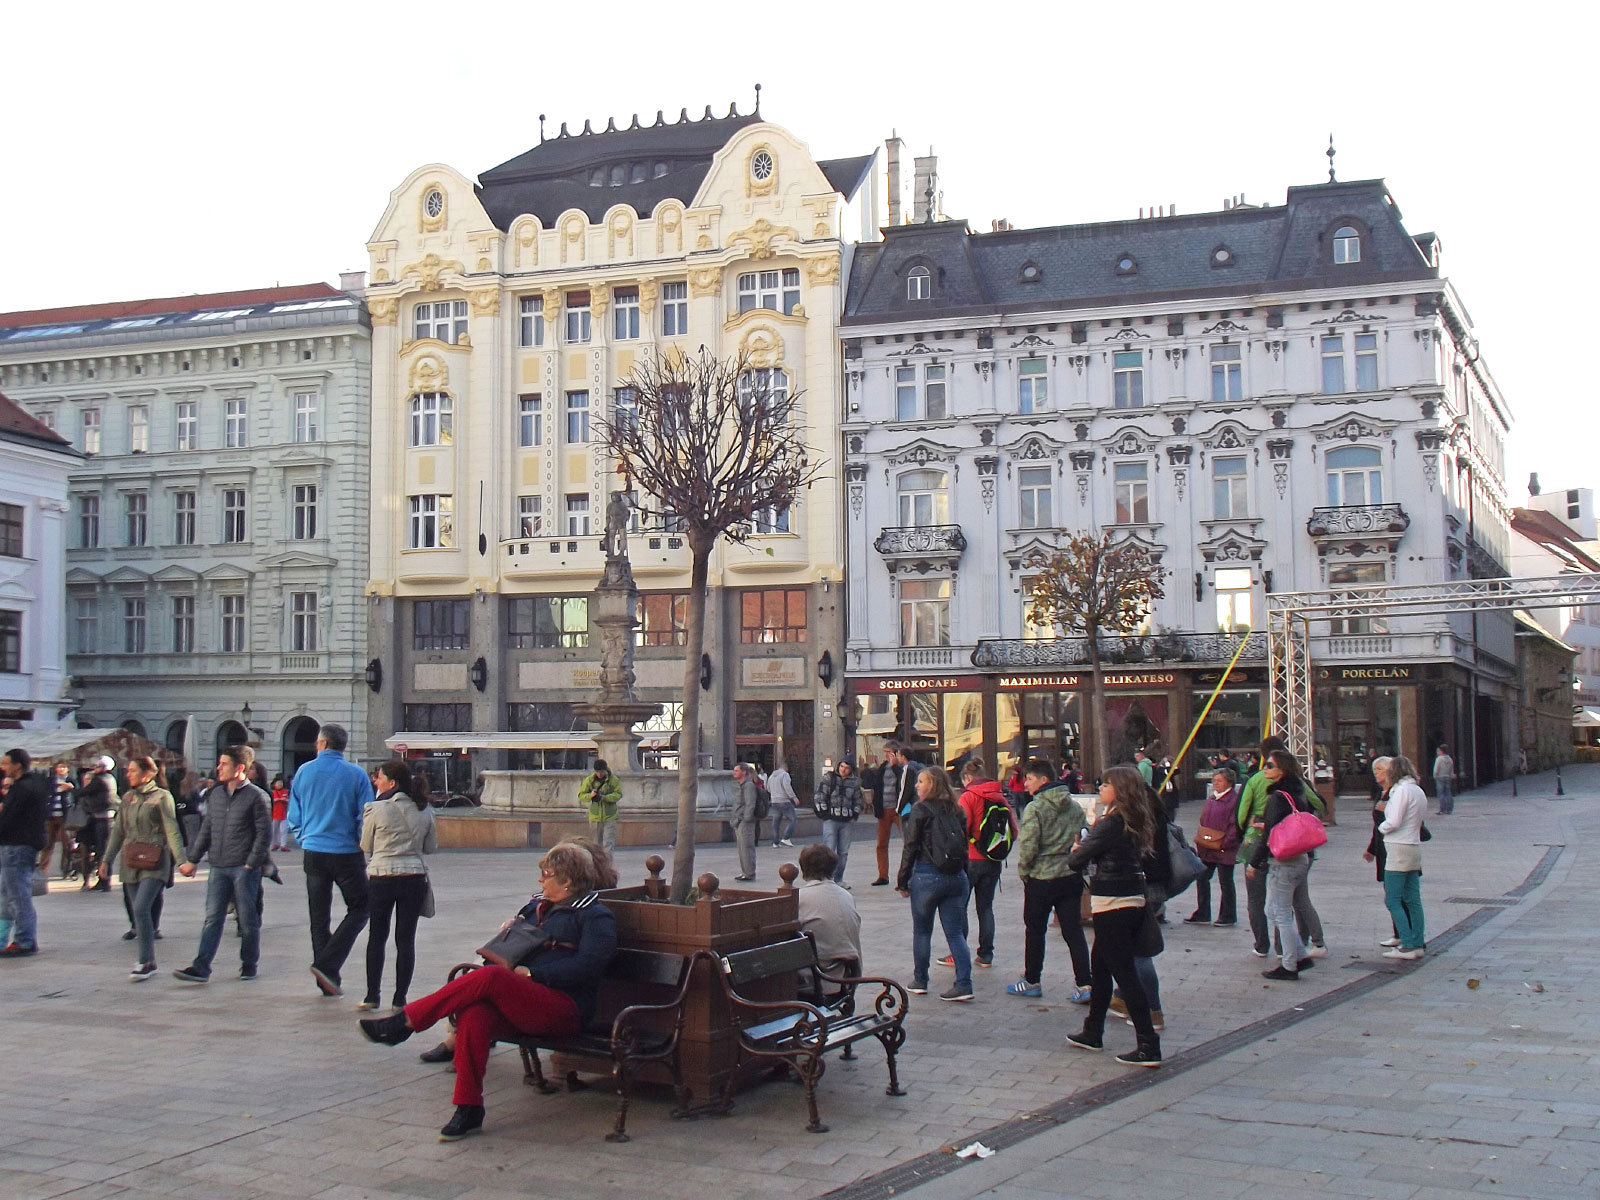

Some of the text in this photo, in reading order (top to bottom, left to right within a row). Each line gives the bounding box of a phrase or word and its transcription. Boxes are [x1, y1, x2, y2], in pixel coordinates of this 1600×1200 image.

[572, 668, 601, 678] Kooper
[1342, 667, 1409, 678] PORCELÁN
[879, 679, 958, 689] SCHOKOCAFE
[1000, 674, 1174, 686] MAXIMILIAN ELIKATESO
